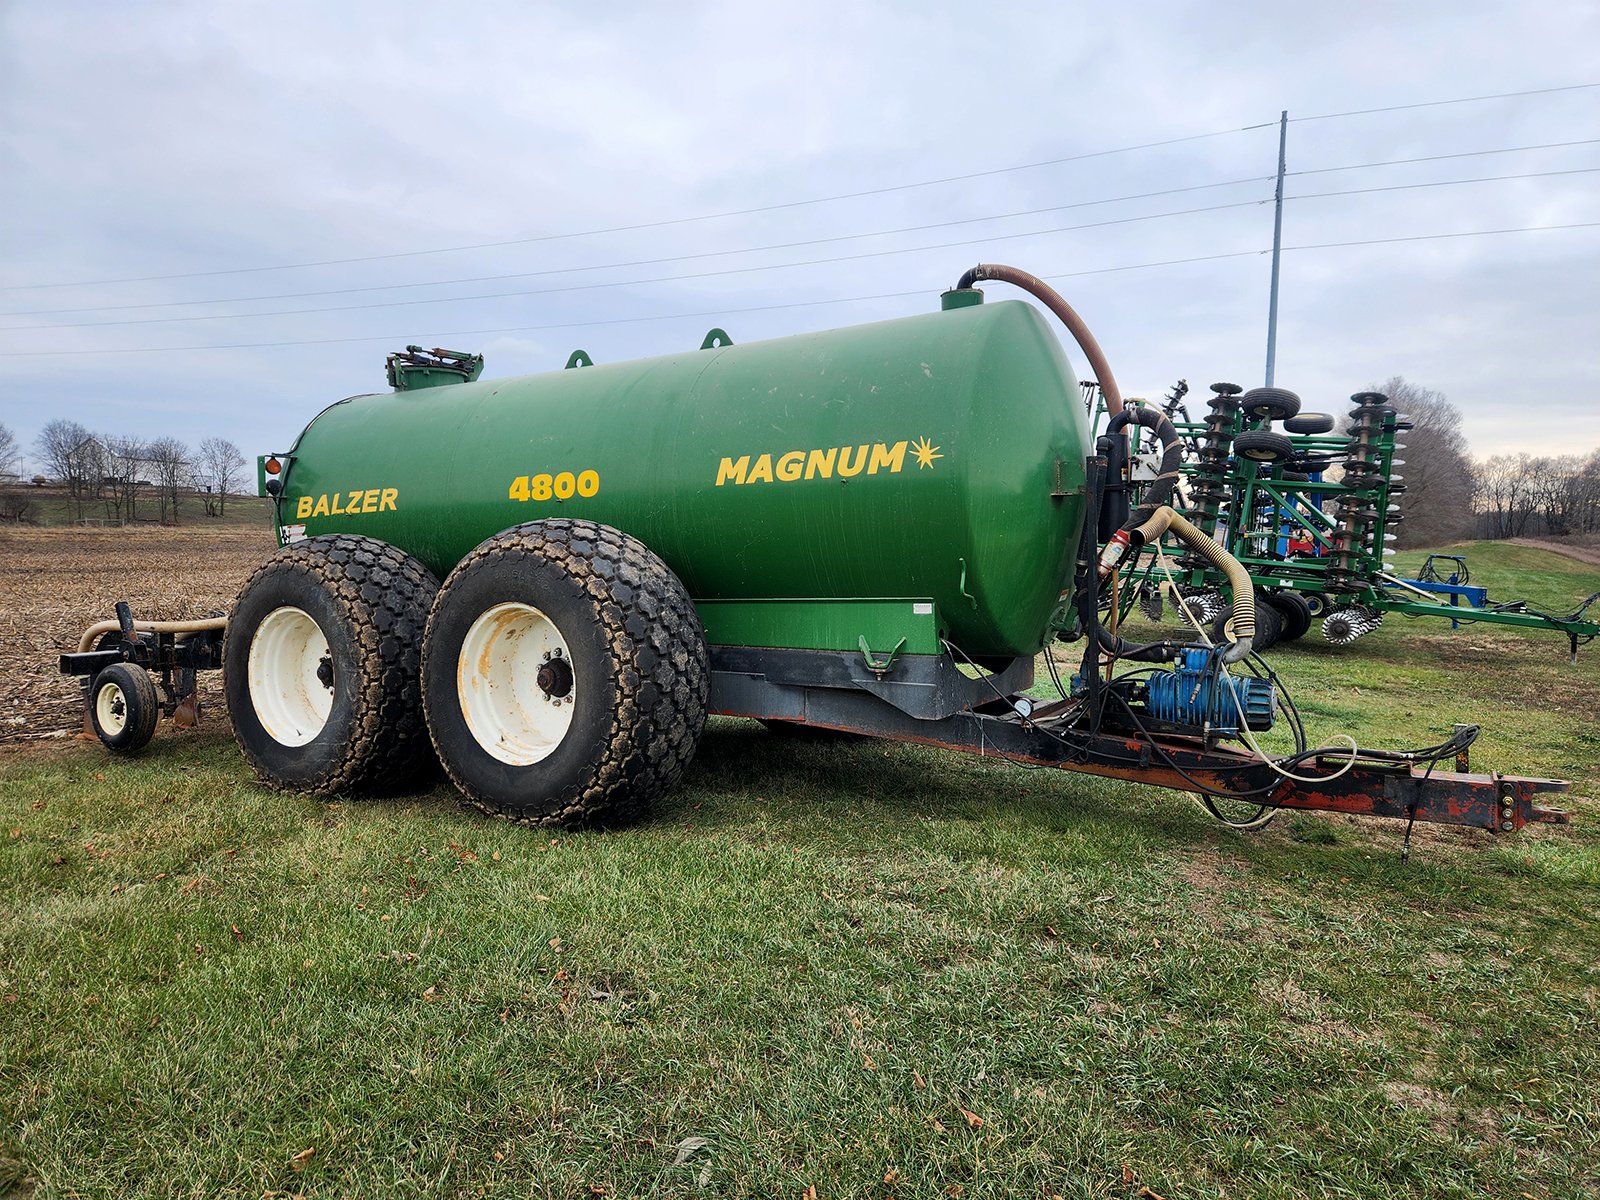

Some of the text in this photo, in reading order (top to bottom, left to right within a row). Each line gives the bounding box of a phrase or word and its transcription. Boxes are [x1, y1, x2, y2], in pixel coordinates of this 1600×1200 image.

[715, 440, 909, 487] MAGNUM
[296, 487, 398, 519] BALZER
[508, 469, 600, 503] 4800
